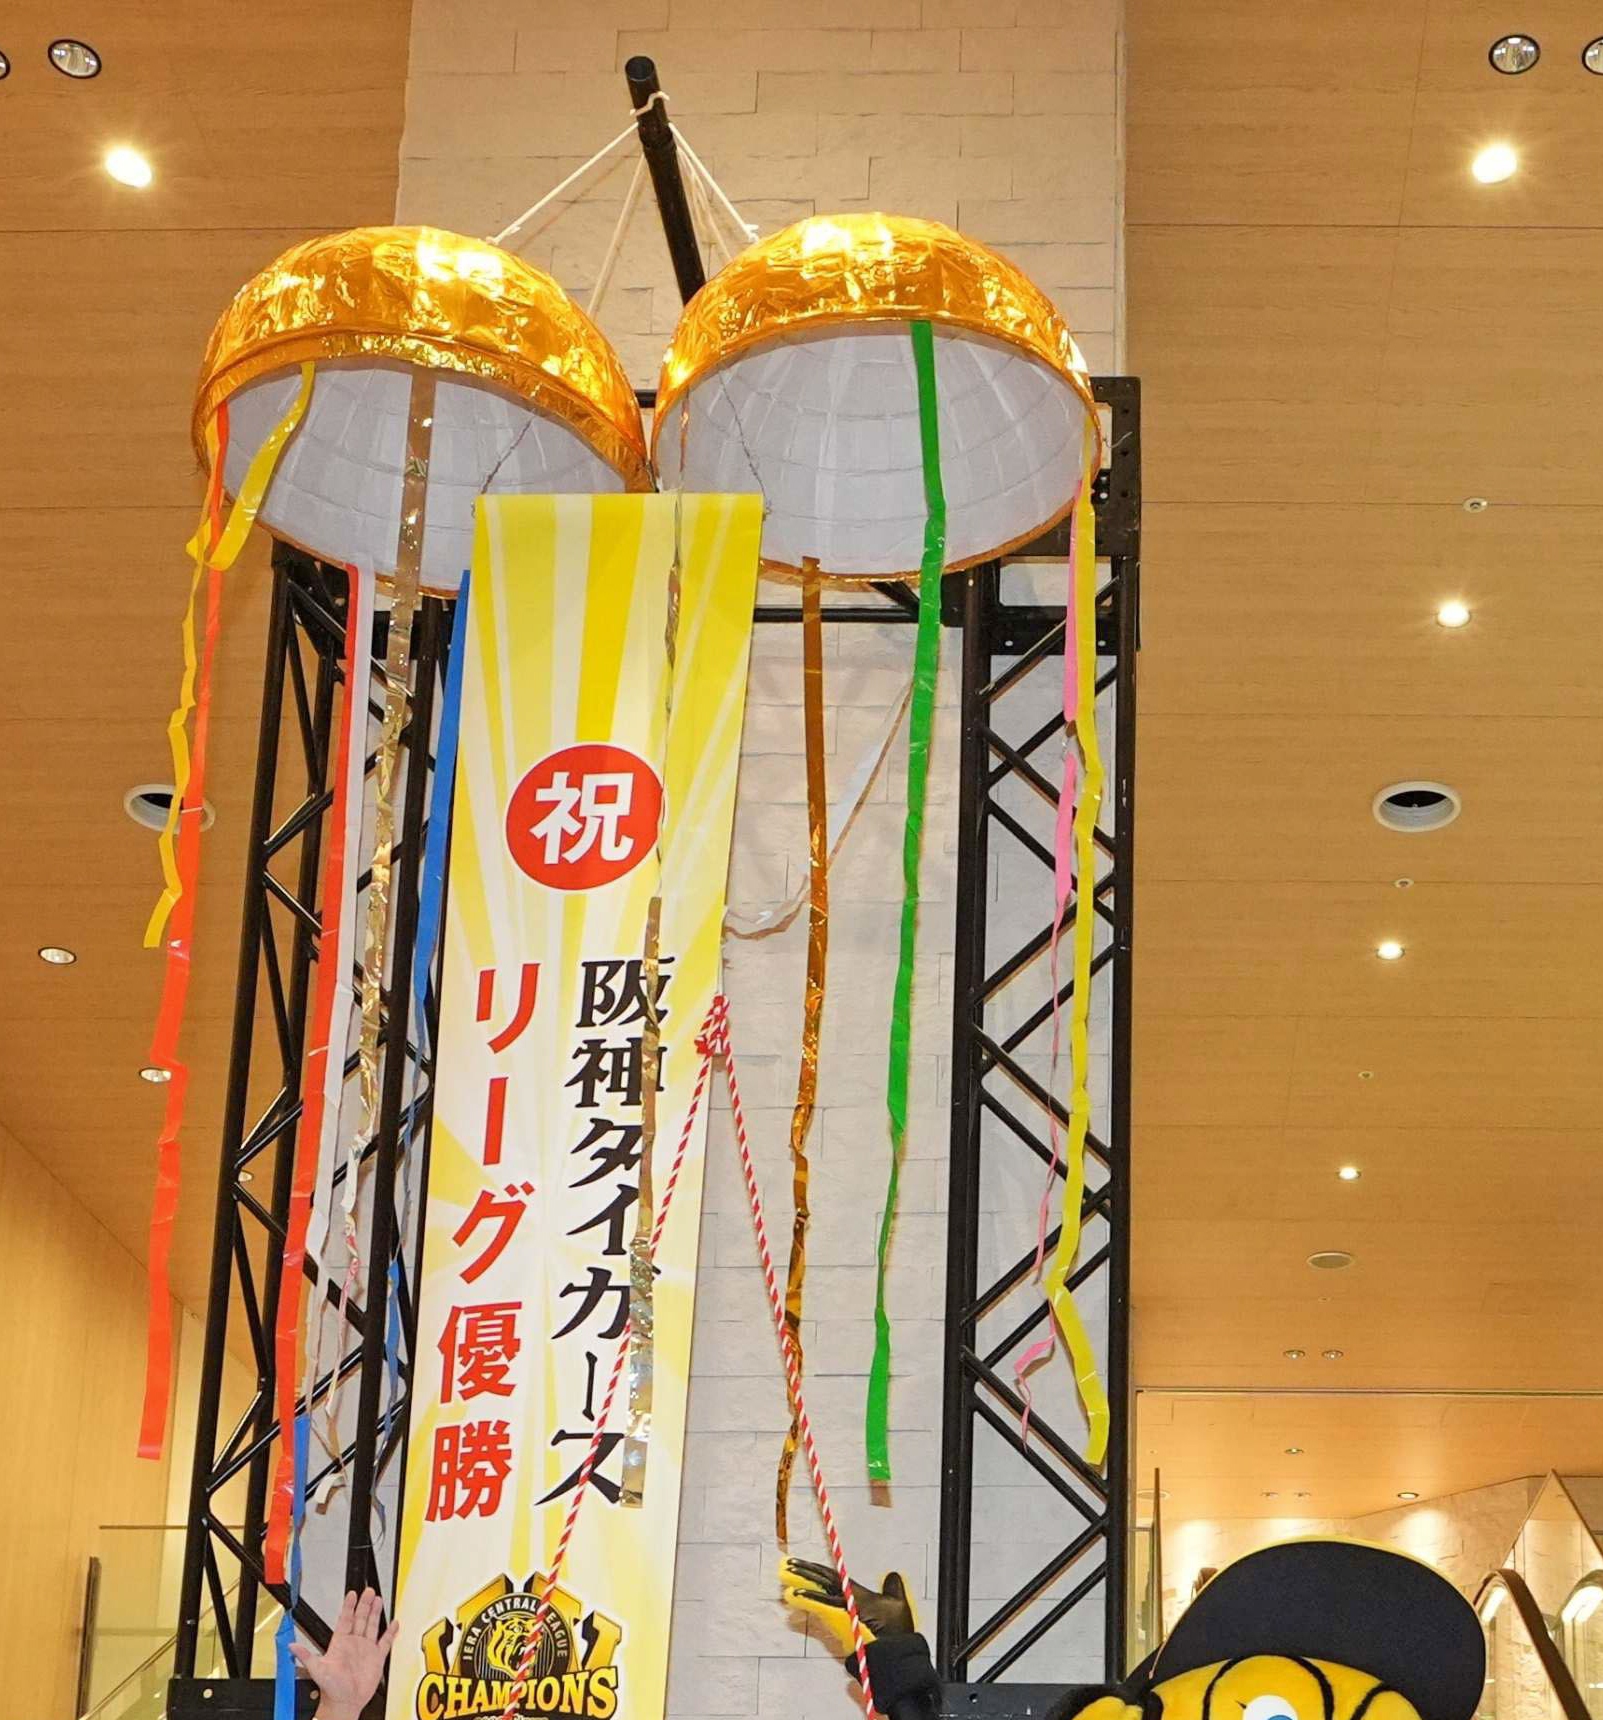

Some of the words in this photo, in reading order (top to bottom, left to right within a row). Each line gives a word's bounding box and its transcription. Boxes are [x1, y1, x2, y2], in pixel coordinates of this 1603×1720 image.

[531, 771, 634, 865] 祝
[425, 963, 541, 1522] リーグ優勝
[534, 956, 676, 1506] 阪神タイガース
[481, 1597, 537, 1623] CENTRAL
